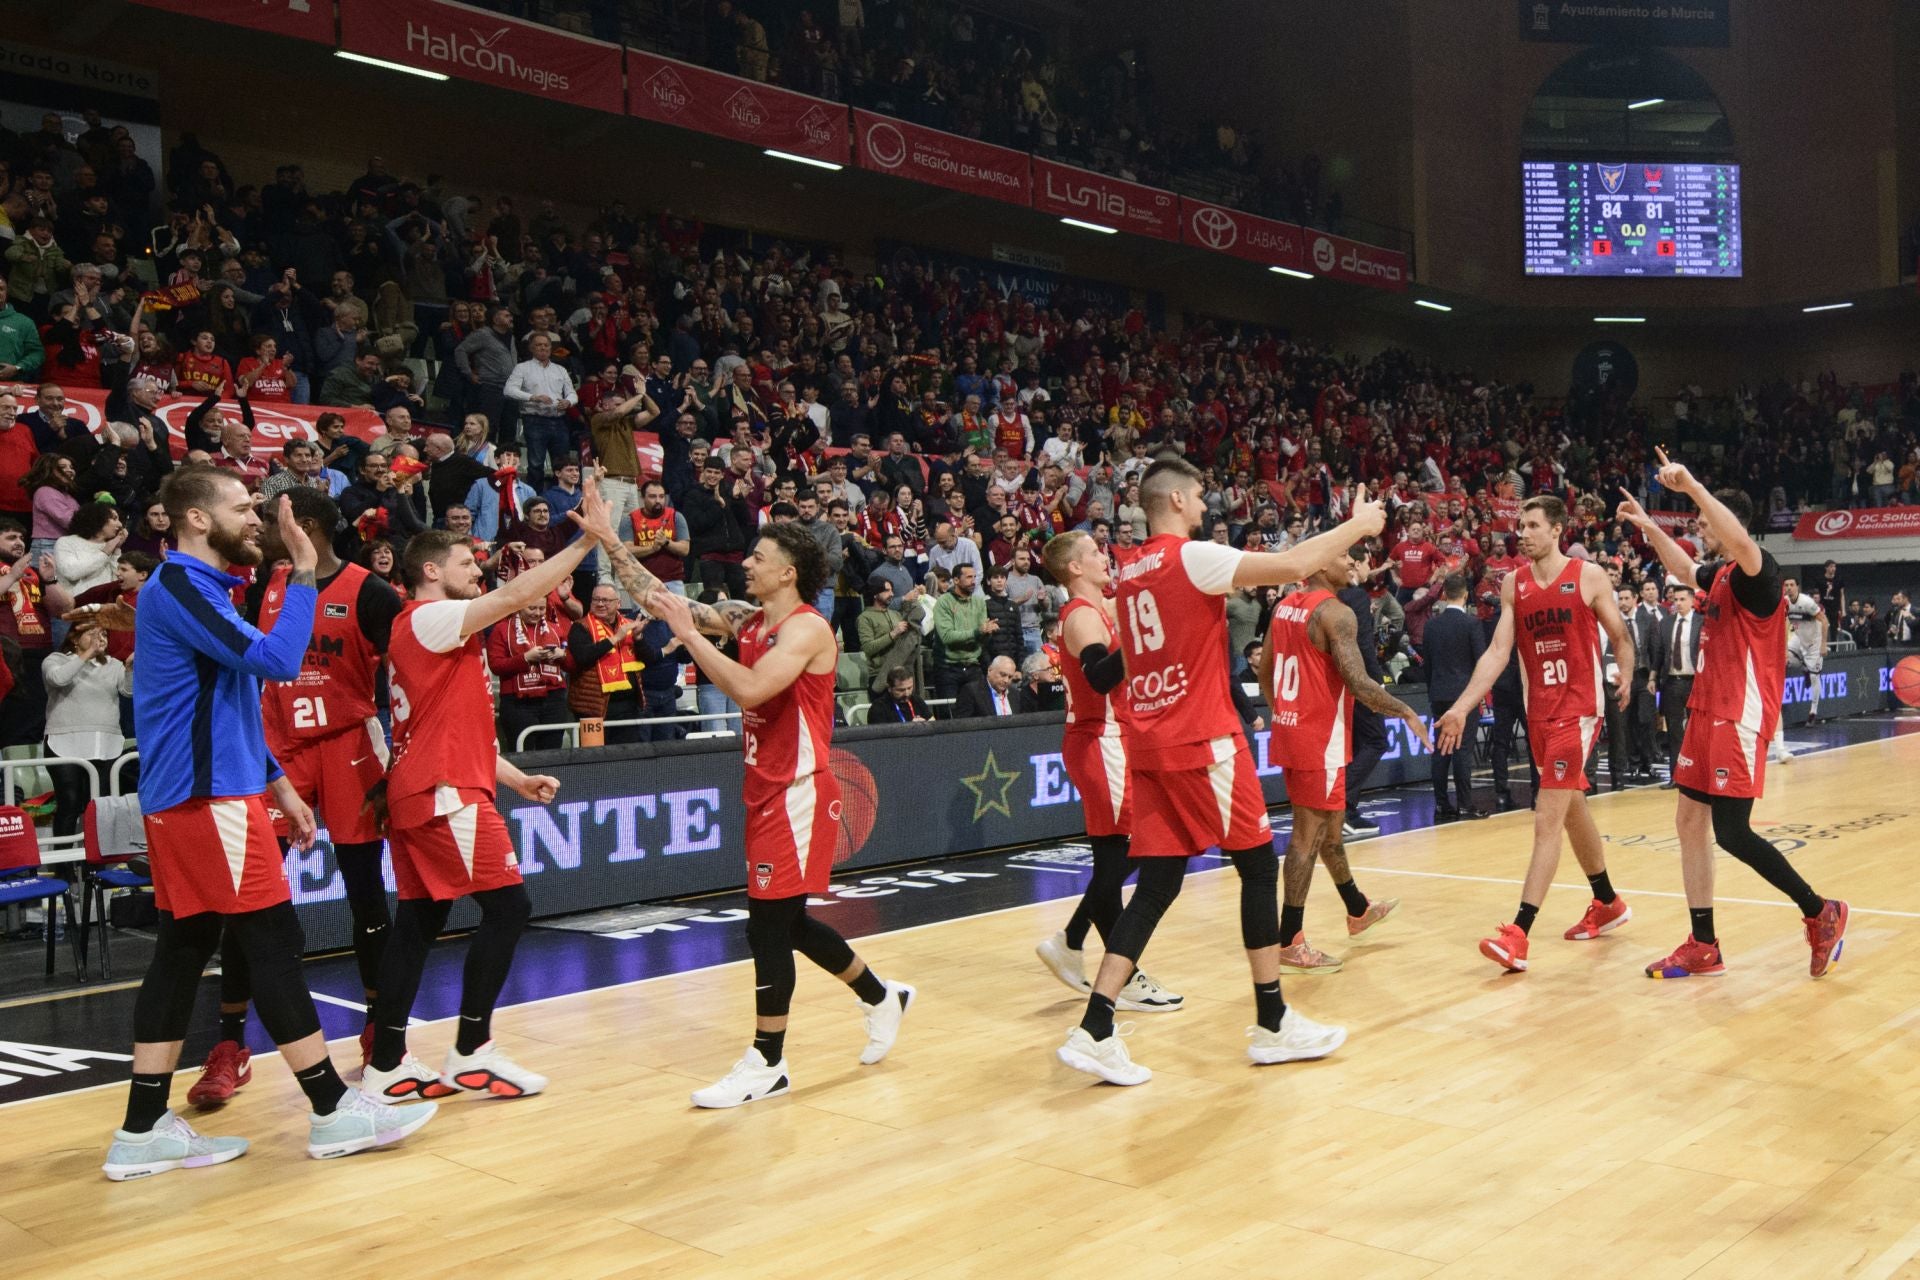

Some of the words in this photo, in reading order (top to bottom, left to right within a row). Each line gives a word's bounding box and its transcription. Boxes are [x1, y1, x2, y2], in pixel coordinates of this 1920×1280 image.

[1653, 7, 1668, 19] de
[1671, 7, 1715, 20] Murcia
[83, 63, 150, 90] Norte
[515, 67, 568, 91] viajes
[653, 87, 686, 105] Niña
[731, 108, 761, 126] Niña
[804, 123, 830, 142] Niña
[913, 153, 958, 174] REGIÓN
[961, 163, 976, 178] DE
[979, 168, 1021, 188] MURCIA
[1602, 202, 1622, 219] 84
[1646, 203, 1662, 219] 81
[1621, 223, 1647, 238] 0.0
[1247, 229, 1294, 253] LABASA
[1599, 242, 1606, 253] 5
[1662, 243, 1669, 254] 5
[1631, 246, 1638, 256] 4
[185, 370, 221, 387] UCAM
[256, 379, 287, 390] UCAM
[1859, 514, 1880, 523] OC
[638, 526, 674, 542] UCM
[1127, 588, 1166, 655] 19
[1524, 607, 1573, 632] UCAM
[310, 634, 344, 659] AM
[1273, 652, 1300, 702] 10
[1542, 658, 1568, 686] 20
[1782, 672, 1848, 704] EVANTE
[293, 696, 328, 729] 21
[583, 722, 602, 734] IRS
[594, 871, 998, 940] MUCIA
